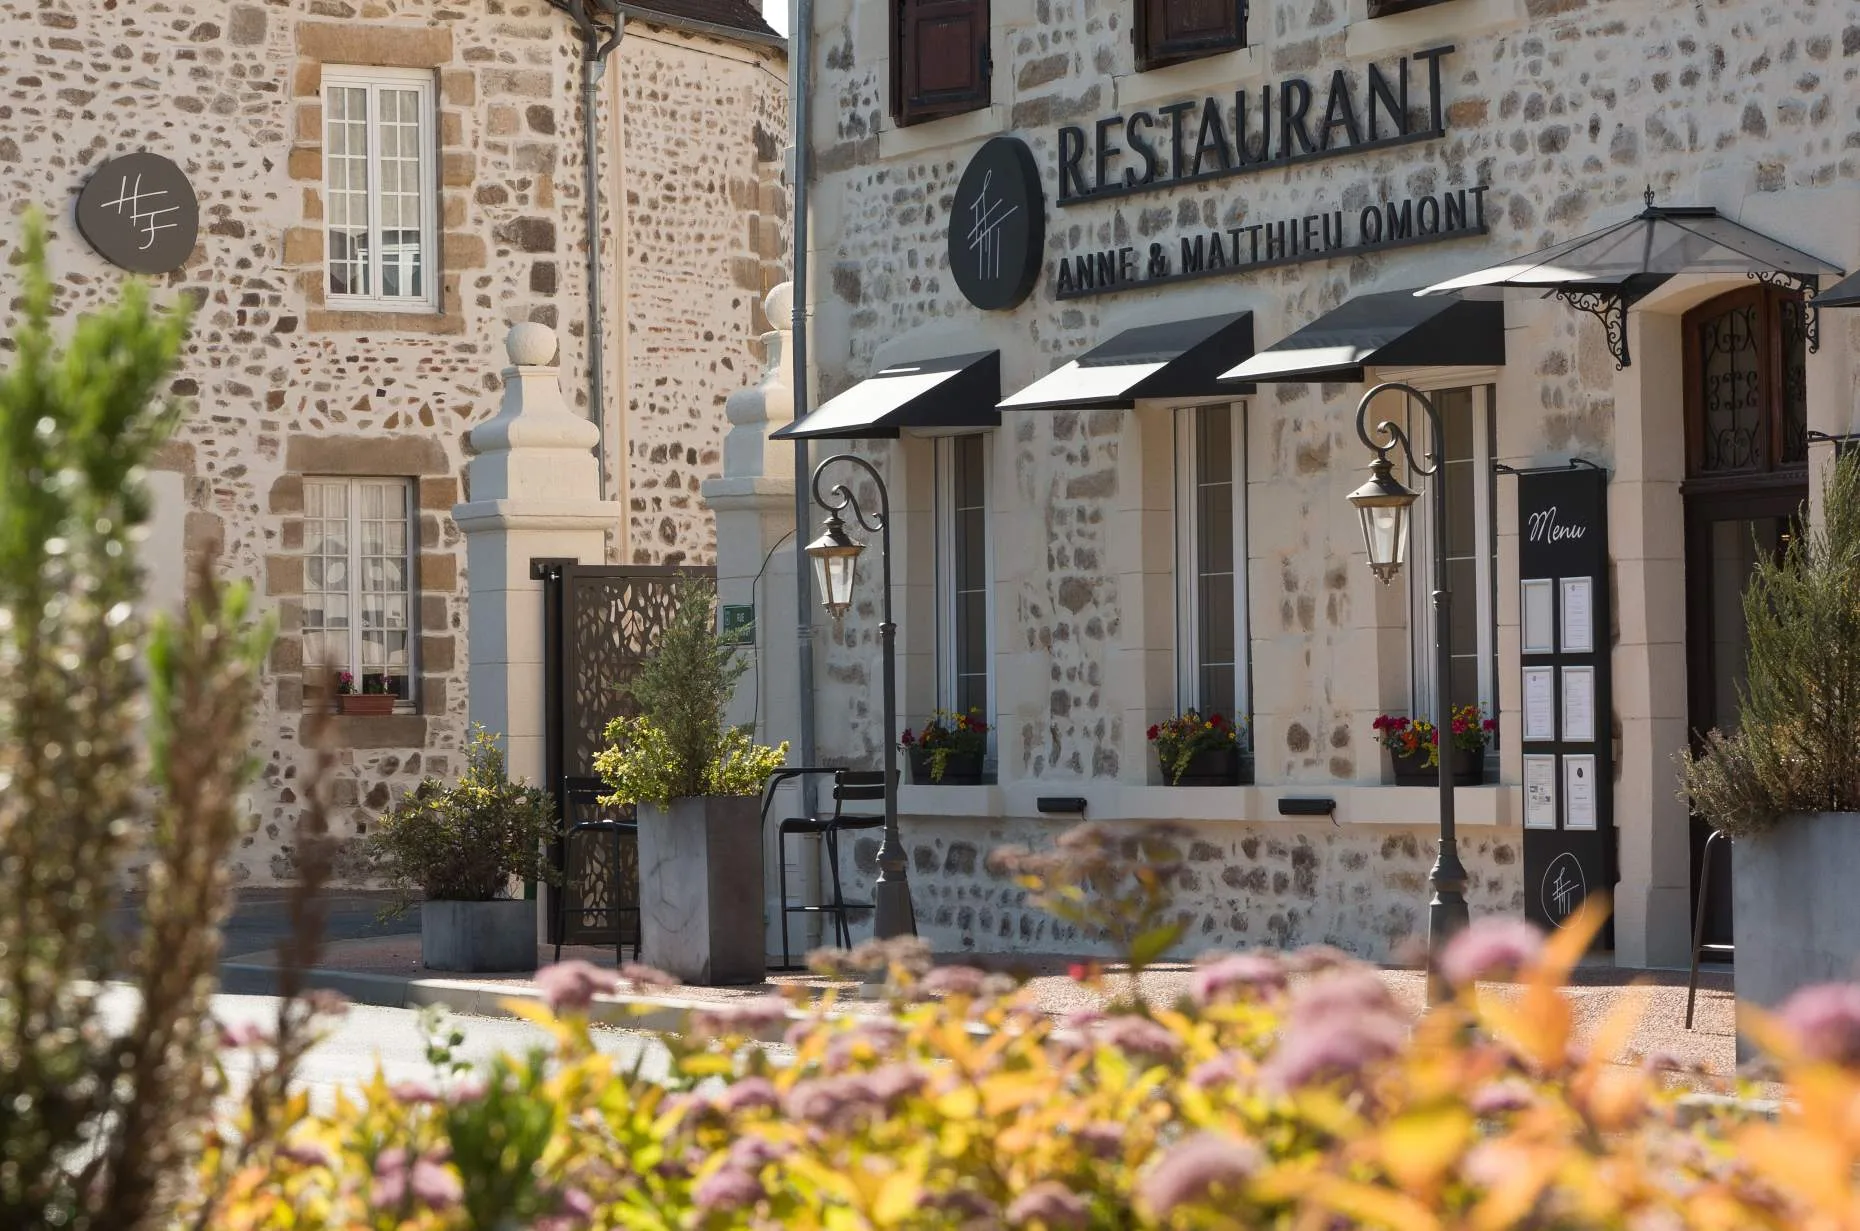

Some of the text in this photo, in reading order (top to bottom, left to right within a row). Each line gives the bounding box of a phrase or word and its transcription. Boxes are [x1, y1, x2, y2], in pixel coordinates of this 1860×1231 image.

[1058, 45, 1456, 199] RESTAURANT
[1057, 186, 1490, 292] ANNE & MATTHIEU OMONT
[1528, 506, 1586, 544] Menu
